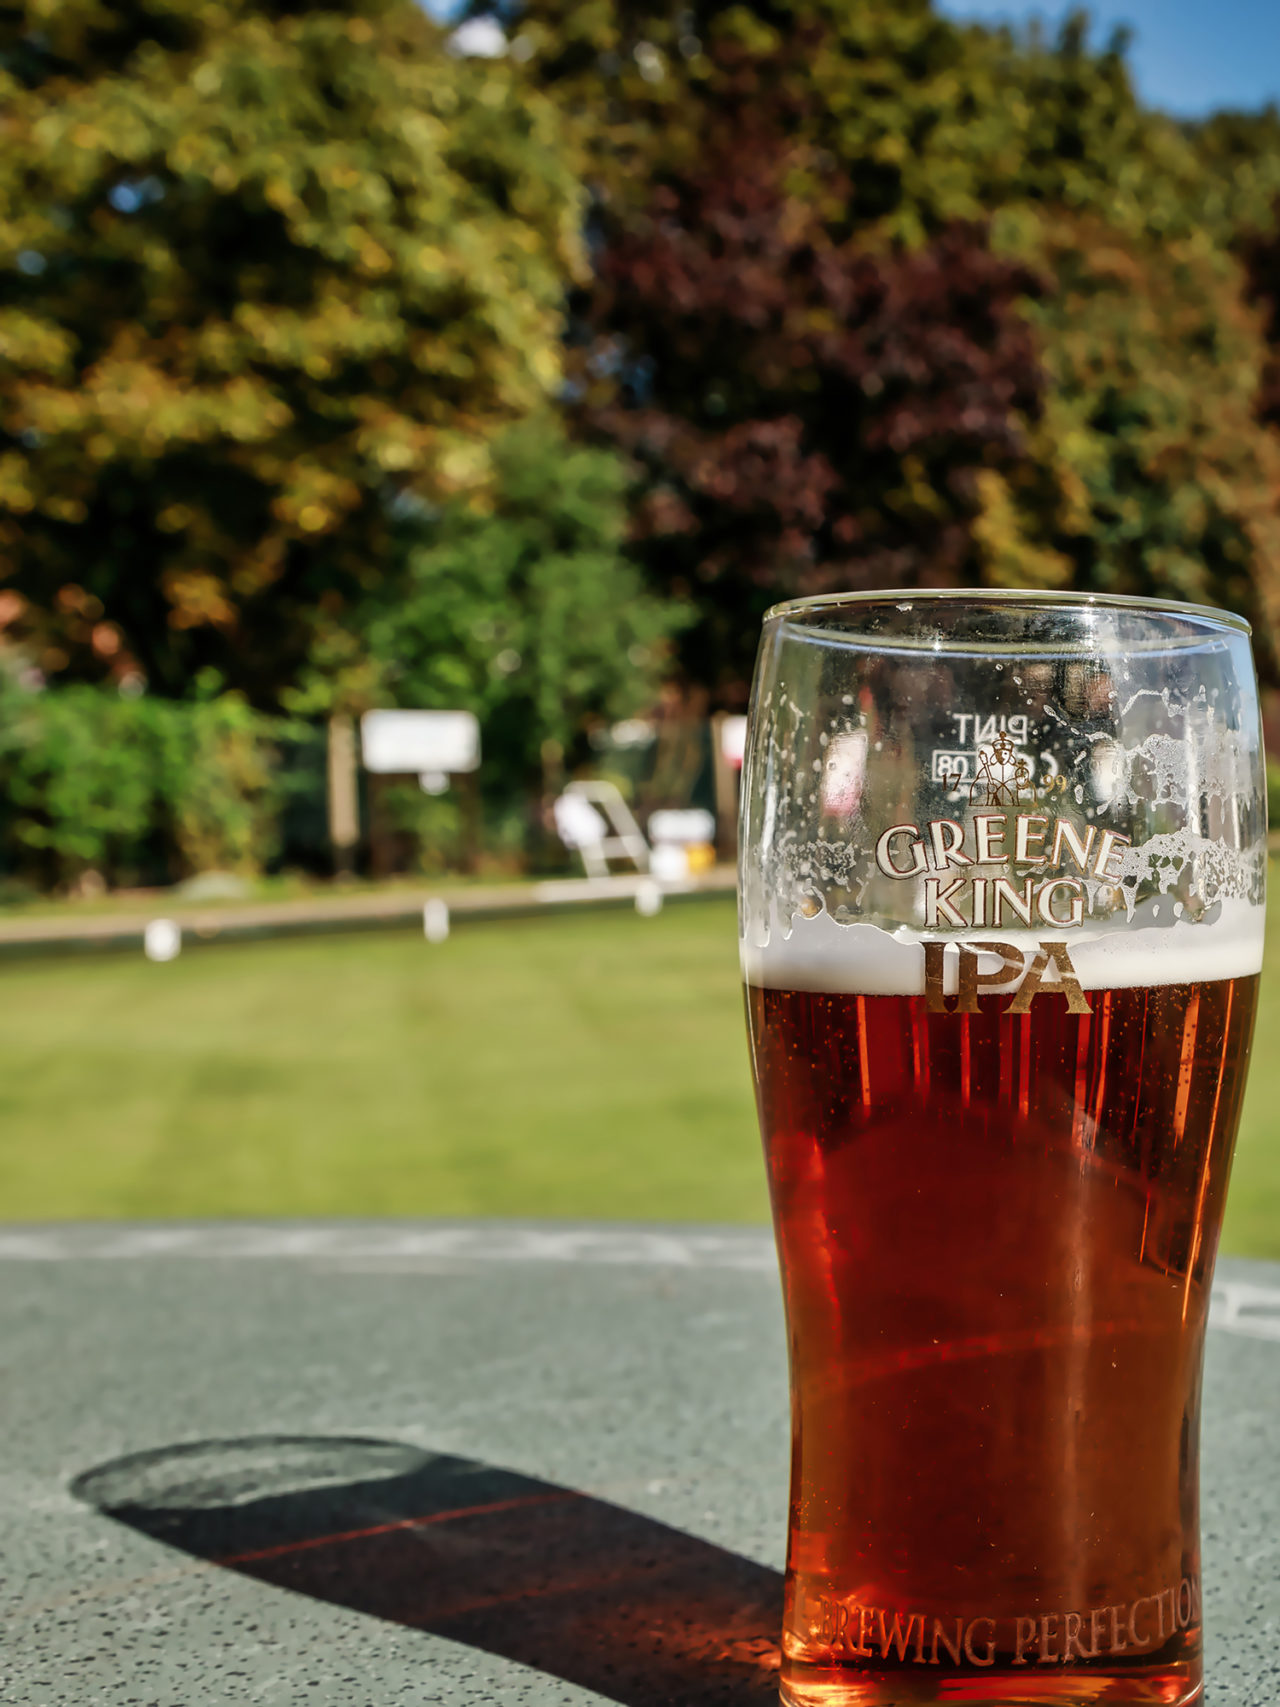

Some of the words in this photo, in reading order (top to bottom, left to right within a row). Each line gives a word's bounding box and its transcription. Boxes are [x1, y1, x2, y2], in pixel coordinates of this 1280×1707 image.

[942, 772, 962, 792] 17
[1043, 774, 1067, 793] 99
[875, 814, 1132, 885] GREENE
[924, 877, 1085, 929] KING
[920, 941, 1094, 1014] IPA
